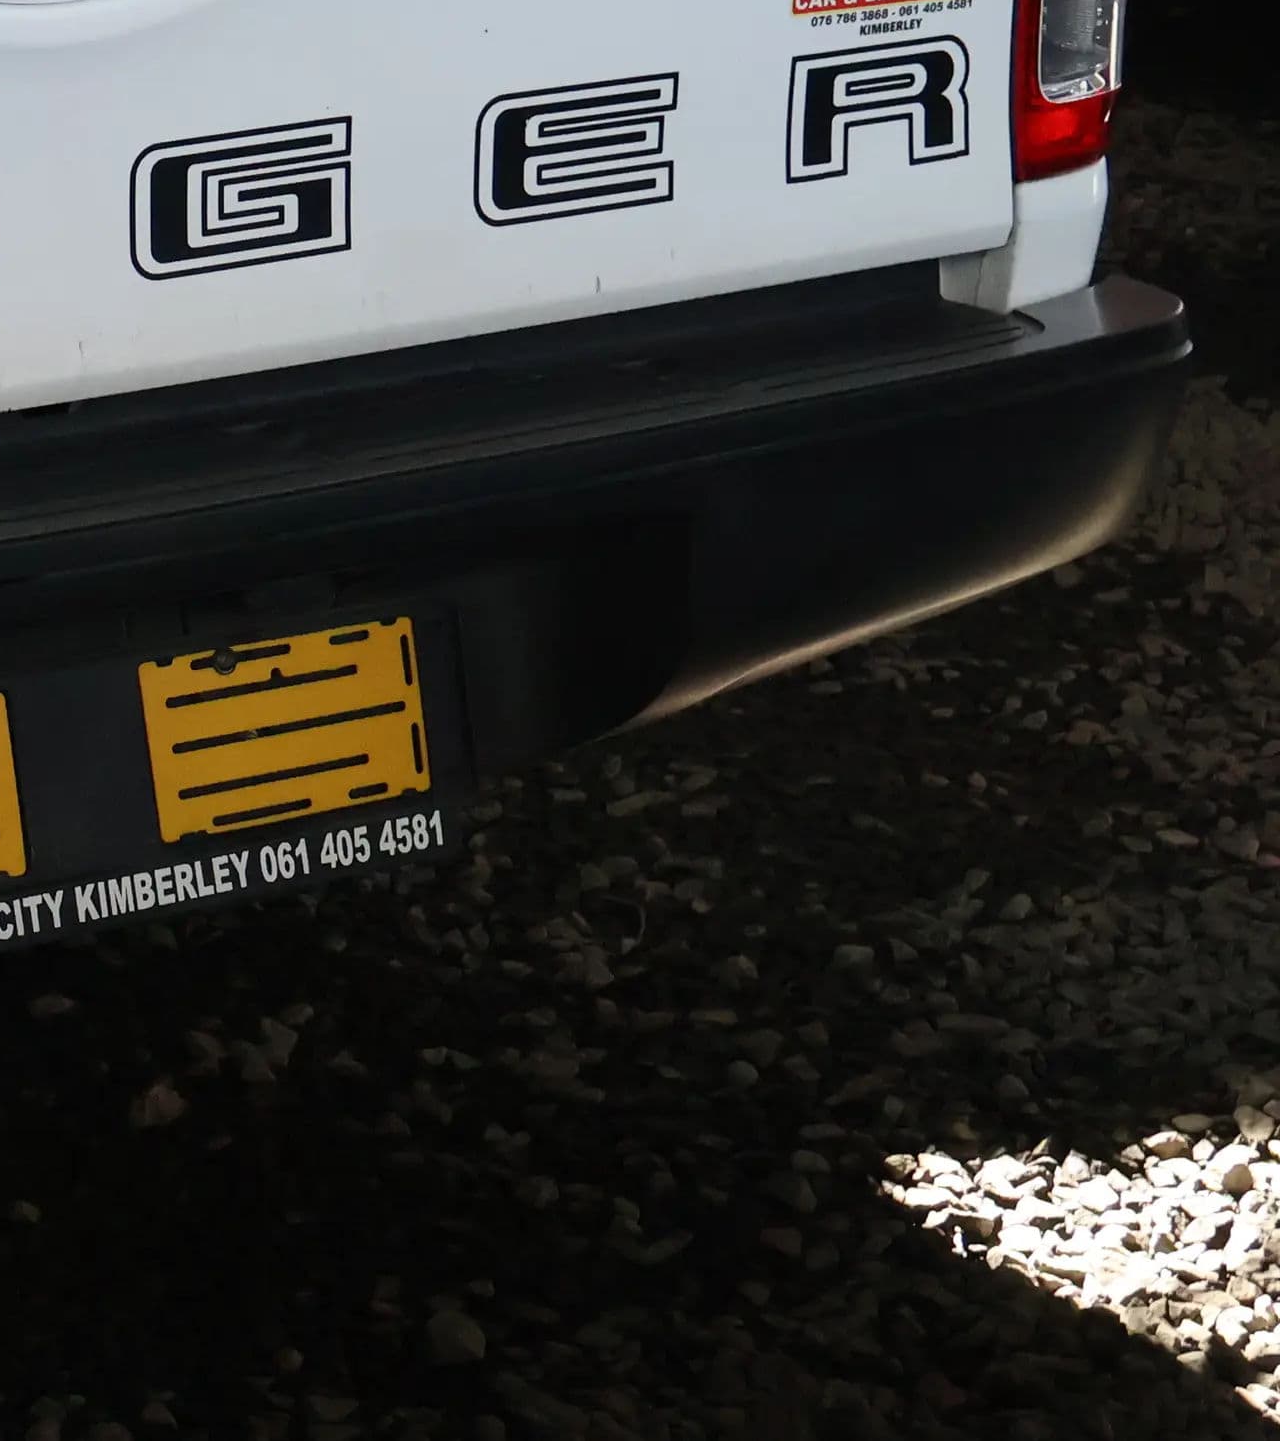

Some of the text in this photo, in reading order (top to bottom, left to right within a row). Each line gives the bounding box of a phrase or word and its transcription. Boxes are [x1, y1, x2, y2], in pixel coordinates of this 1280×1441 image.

[810, 15, 833, 28] 076
[836, 12, 857, 25] 786
[860, 8, 889, 22] 3868
[898, 4, 919, 18] 061
[922, 1, 944, 14] 405
[859, 18, 924, 37] KIMBERLEY
[74, 849, 251, 924] KIMBERLEY
[259, 837, 311, 884] 061
[319, 825, 371, 869] 405
[378, 809, 444, 857] 4581
